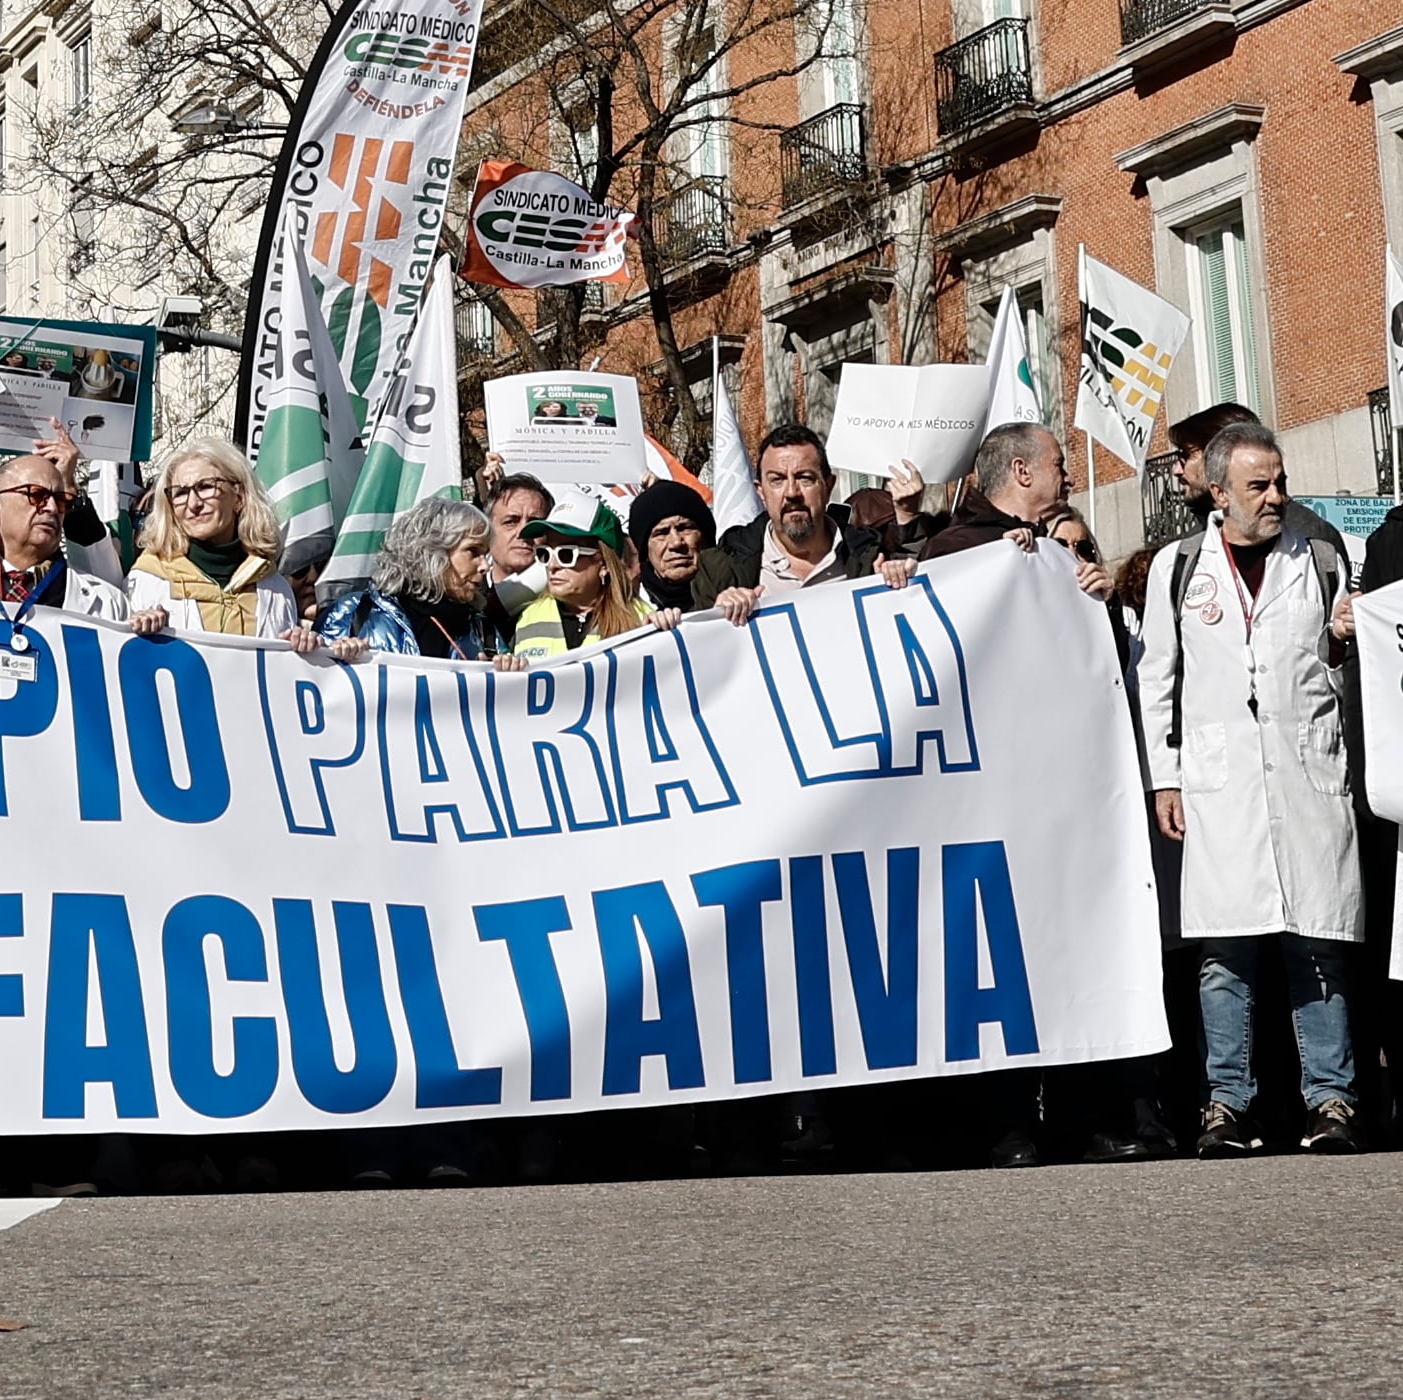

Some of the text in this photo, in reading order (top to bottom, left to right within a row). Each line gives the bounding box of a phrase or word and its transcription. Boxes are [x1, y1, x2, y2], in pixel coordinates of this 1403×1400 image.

[350, 10, 475, 43] SINDICATO MÉDICO
[344, 33, 471, 77] CESM
[344, 66, 458, 91] Castilla-La Mancha
[346, 79, 446, 119] DEFIÉNDELA
[494, 189, 569, 213] SINDICATO
[394, 157, 452, 317] Mancha
[485, 245, 623, 271] Castilla-La Mancha
[532, 387, 546, 399] 2
[548, 391, 608, 400] GOBERNANDO
[515, 427, 556, 436] MÓNICA
[575, 428, 617, 436] PADILLA
[846, 416, 861, 426] YO
[863, 417, 895, 429] APOYO
[898, 419, 904, 429] A
[925, 416, 975, 430] MÉDICOS
[257, 622, 741, 844] PARA
[746, 574, 981, 788] LA
